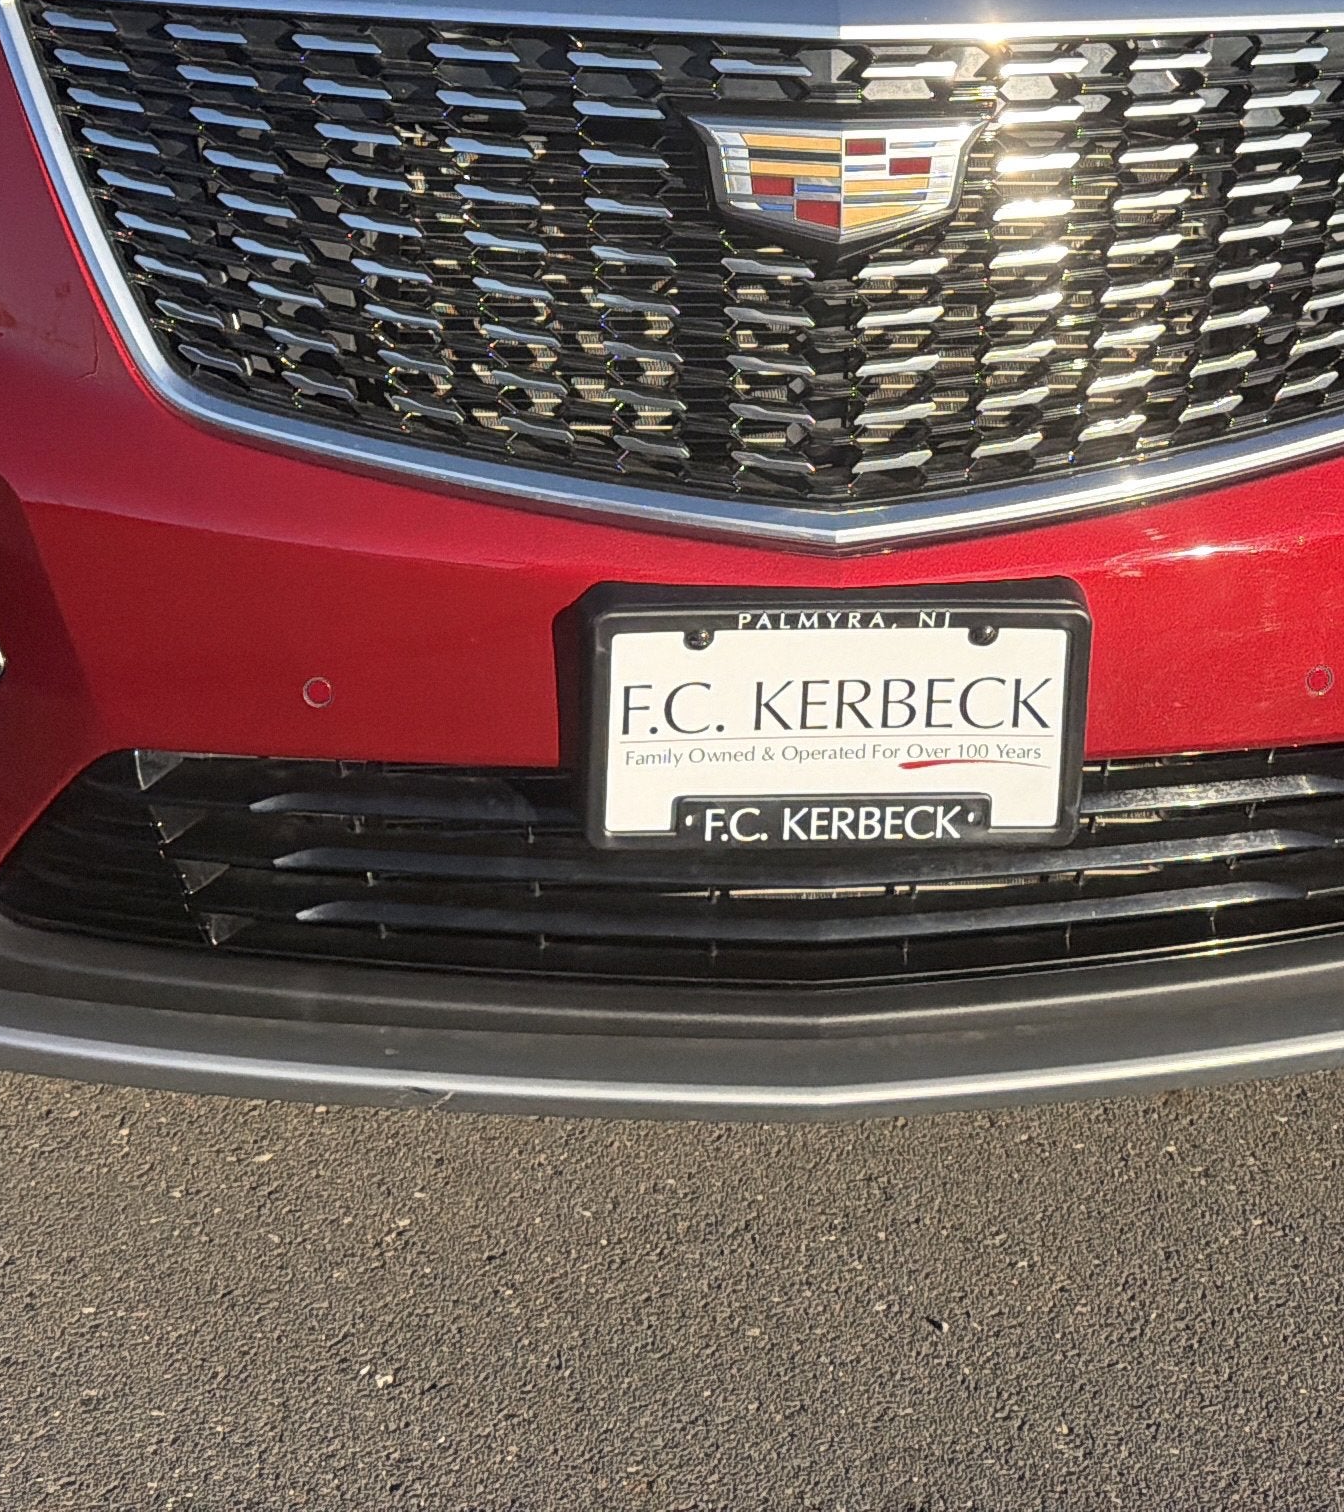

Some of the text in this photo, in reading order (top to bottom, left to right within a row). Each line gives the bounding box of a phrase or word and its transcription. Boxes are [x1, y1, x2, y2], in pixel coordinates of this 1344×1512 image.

[738, 610, 952, 630] PALMYRA, NJ
[621, 676, 1054, 736] F.C. KERBECK
[625, 741, 1042, 769] Family Owned & Operated For Over 100 Years
[704, 806, 961, 842] F.C. KERBECK
